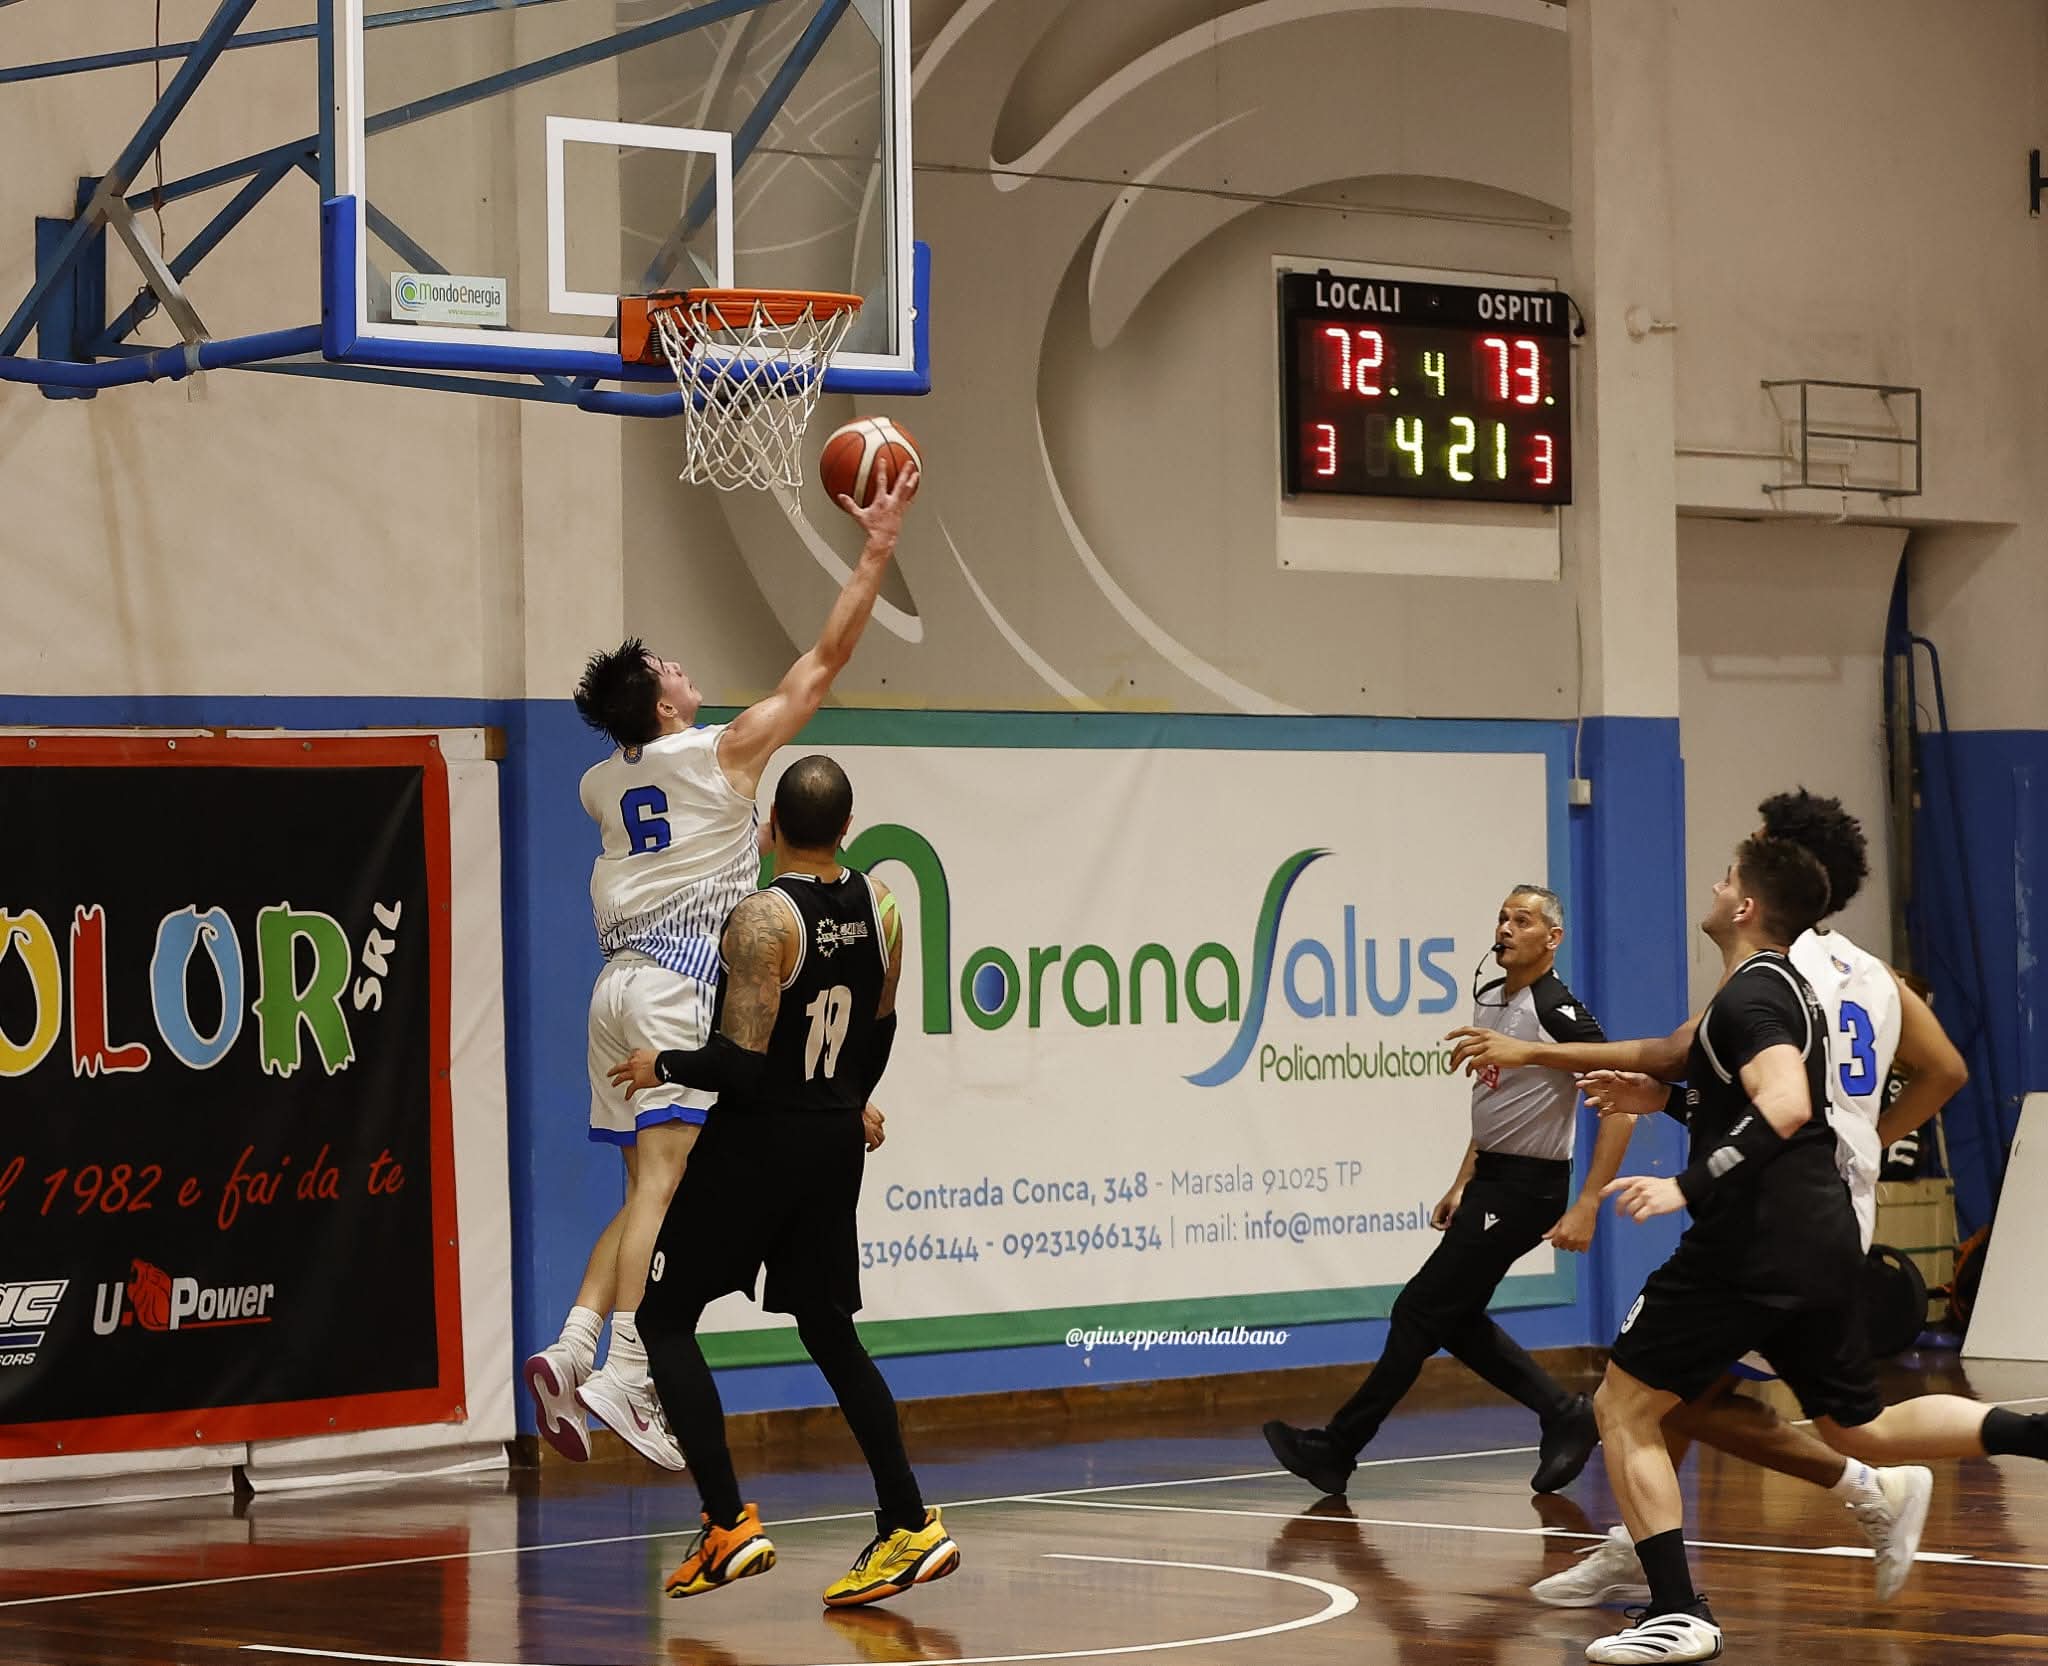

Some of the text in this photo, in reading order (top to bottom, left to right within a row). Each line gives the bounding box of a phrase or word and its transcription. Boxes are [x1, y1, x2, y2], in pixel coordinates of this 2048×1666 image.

[1316, 281, 1400, 313] LOCALI
[1478, 293, 1552, 324] OSPITI
[1424, 351, 1445, 396] 4
[1317, 424, 1336, 475] 3
[1534, 435, 1552, 484] 3
[620, 785, 672, 856] 6
[353, 900, 401, 1012] SRL
[806, 985, 852, 1081] 19
[1840, 1000, 1877, 1097] 3
[40, 1164, 162, 1216] 1982
[178, 1177, 201, 1207] e
[218, 1145, 291, 1230] fai
[297, 1144, 340, 1199] da
[368, 1149, 405, 1195] te
[886, 1177, 1003, 1211] Contrada
[1013, 1178, 1096, 1206] Conca,
[1104, 1172, 1148, 1204] 348
[1171, 1164, 1253, 1195] Marsala
[1262, 1167, 1328, 1193] 91025
[1335, 1161, 1362, 1186] TP
[1003, 1223, 1162, 1258] 09231966134
[1185, 1212, 1237, 1244] mail:
